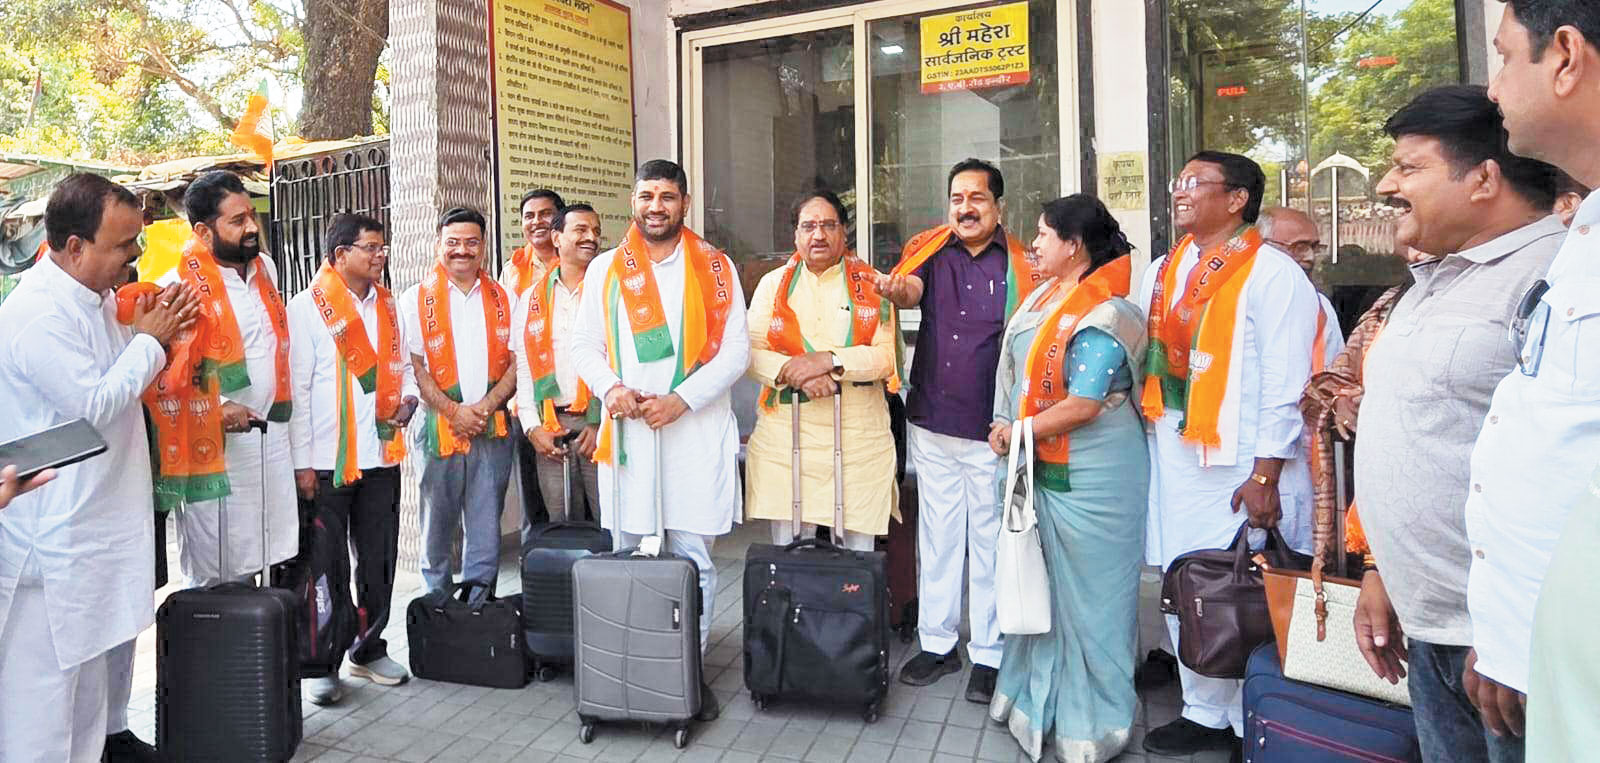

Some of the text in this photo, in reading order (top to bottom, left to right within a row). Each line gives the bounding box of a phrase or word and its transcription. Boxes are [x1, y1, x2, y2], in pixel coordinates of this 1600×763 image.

[955, 10, 993, 22] कार्यालय
[938, 22, 1011, 48] श्री महेश
[924, 44, 1026, 68] सार्वजनिक ट्रस्ट
[926, 70, 950, 80] GSTIN
[1216, 86, 1248, 97] PULL
[313, 286, 334, 321] BJP
[424, 295, 438, 333] BJP
[490, 288, 505, 321] BJP
